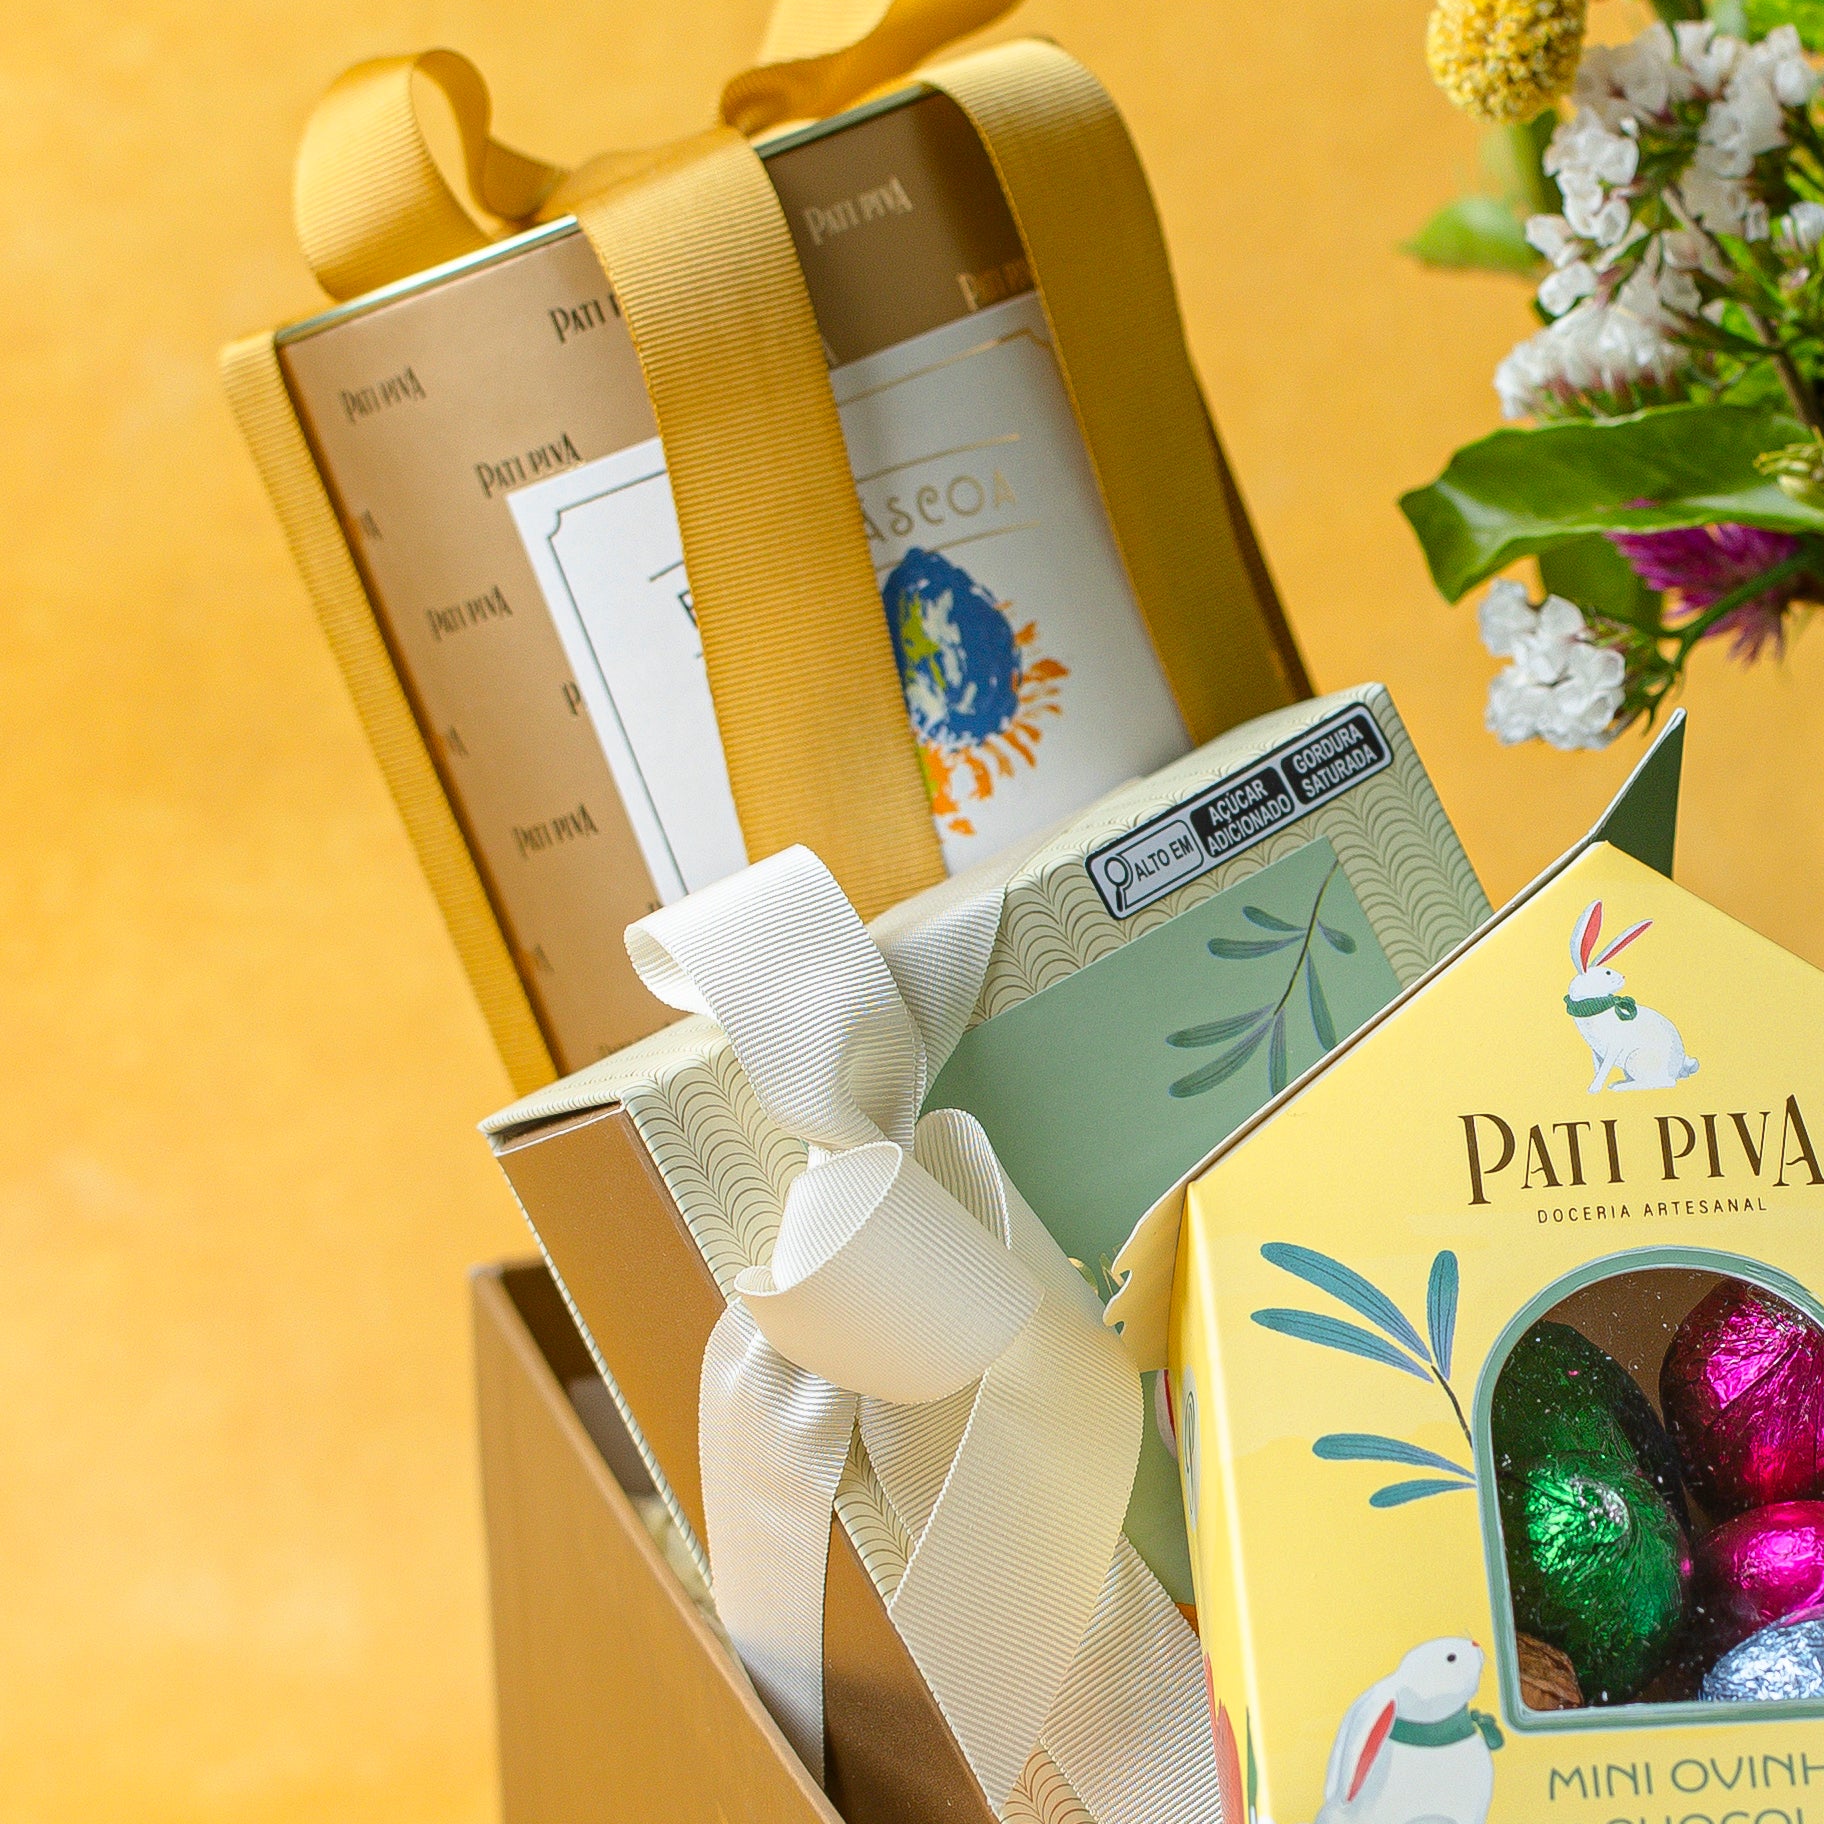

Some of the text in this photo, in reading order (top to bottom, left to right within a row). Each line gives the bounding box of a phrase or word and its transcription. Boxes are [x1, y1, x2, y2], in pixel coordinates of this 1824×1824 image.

[548, 299, 607, 344] PATI
[473, 432, 582, 499] PATI PIVA
[1292, 722, 1364, 774] GORDURA
[1301, 744, 1378, 799] SATURADA
[1206, 795, 1292, 856] ADICIONADO
[1208, 779, 1269, 827] AÇÚCAR
[1134, 834, 1195, 882] ALTO EM
[1456, 1112, 1626, 1207] PATI
[1537, 1197, 1769, 1225] DOCERIA ARTESANAL
[1548, 1761, 1654, 1802] MINI
